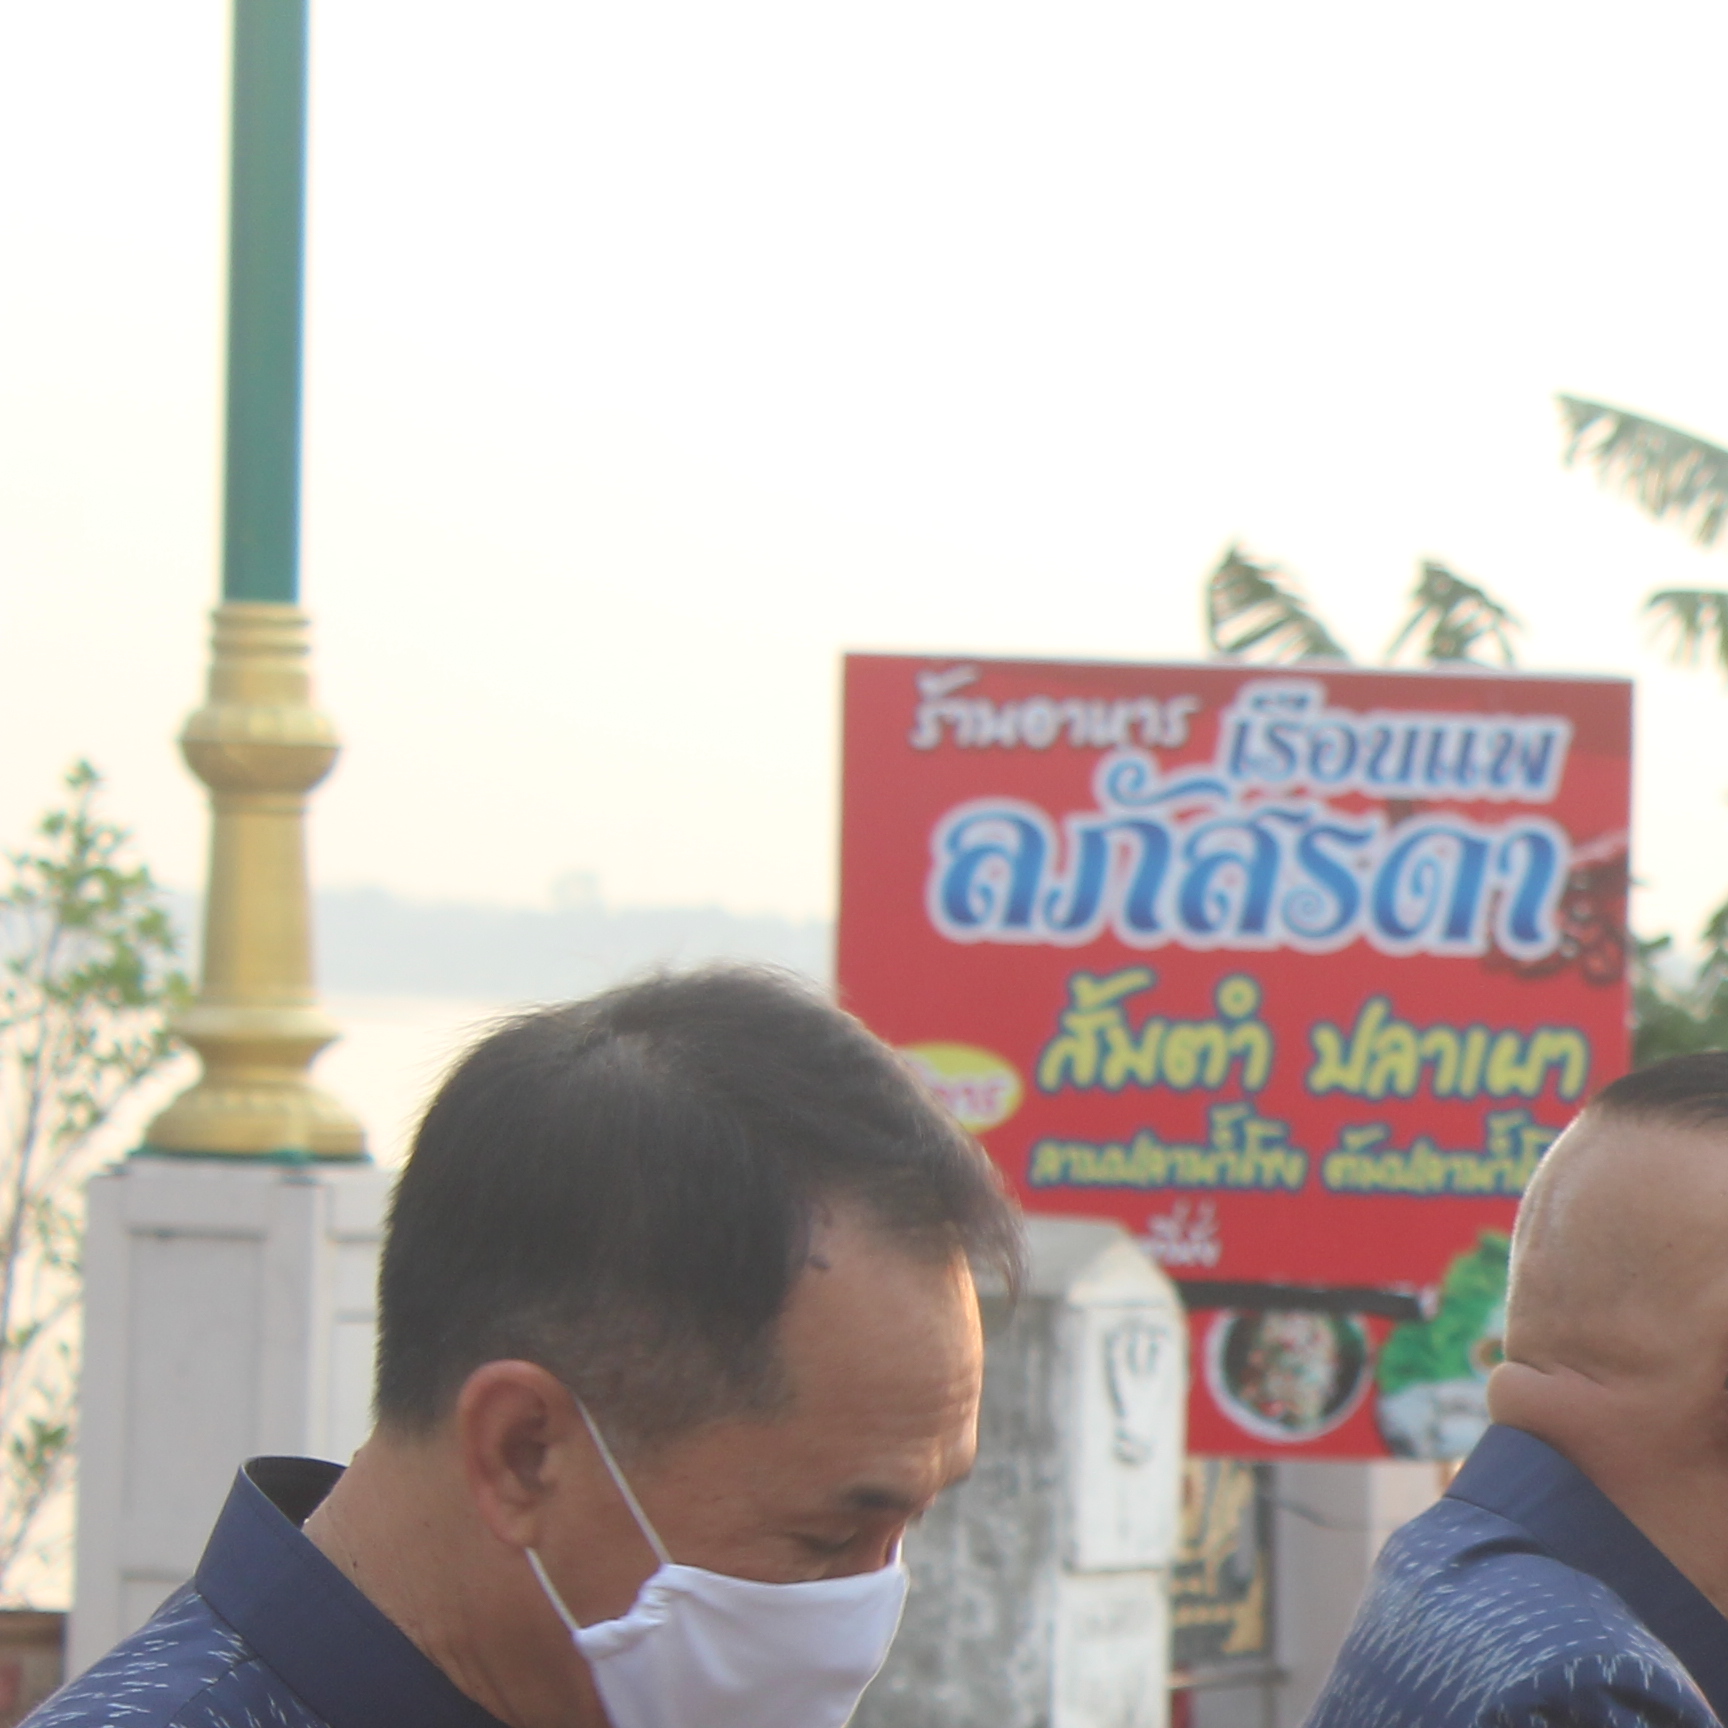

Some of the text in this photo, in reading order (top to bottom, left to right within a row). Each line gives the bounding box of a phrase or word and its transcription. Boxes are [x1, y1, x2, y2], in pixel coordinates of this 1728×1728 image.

[912, 669, 1568, 798] ร้านอาหาร เรือนแพ
[1039, 970, 1271, 1091] ส้มตำ
[1310, 997, 1588, 1098] ปลาเผา
